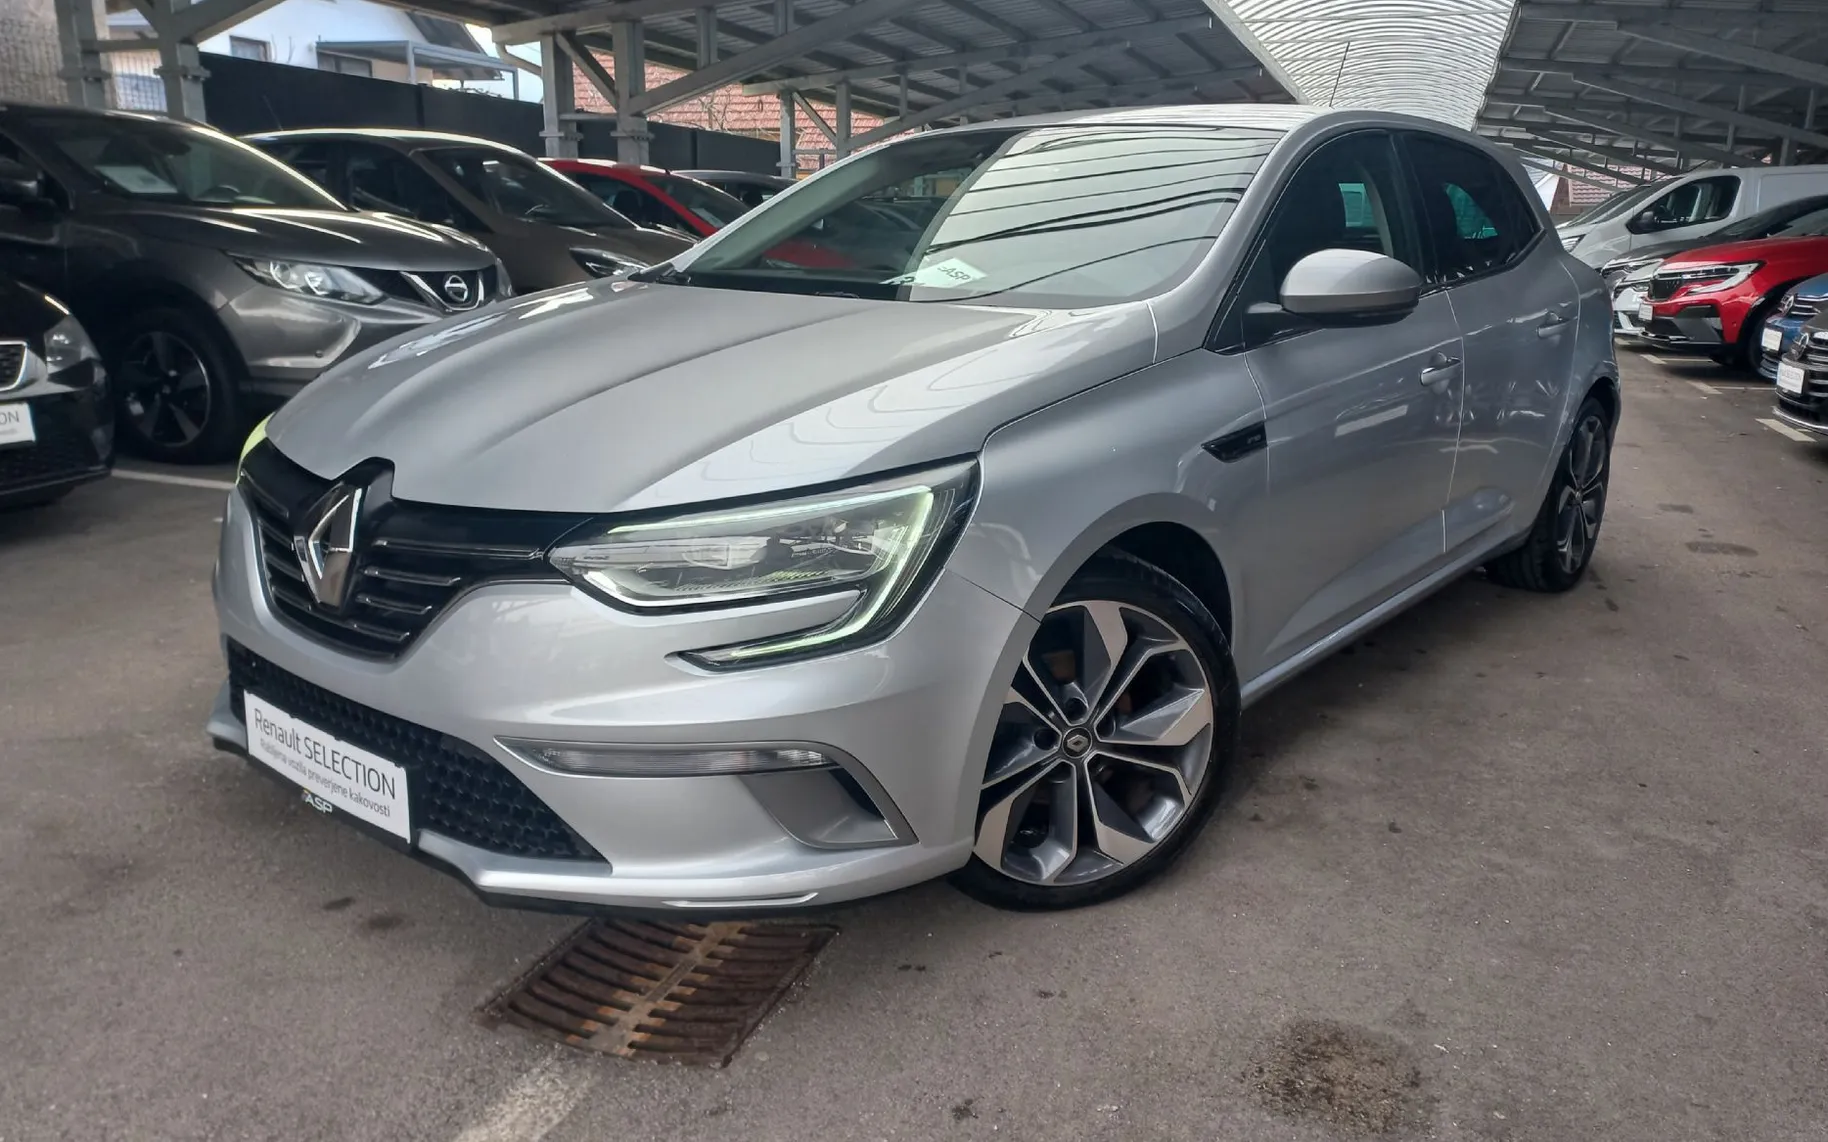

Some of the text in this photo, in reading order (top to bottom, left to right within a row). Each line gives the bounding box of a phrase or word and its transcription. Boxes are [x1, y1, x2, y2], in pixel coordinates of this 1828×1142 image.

[254, 708, 302, 754] Renault
[303, 736, 396, 800] SELECTION
[349, 787, 391, 817] kakovosti
